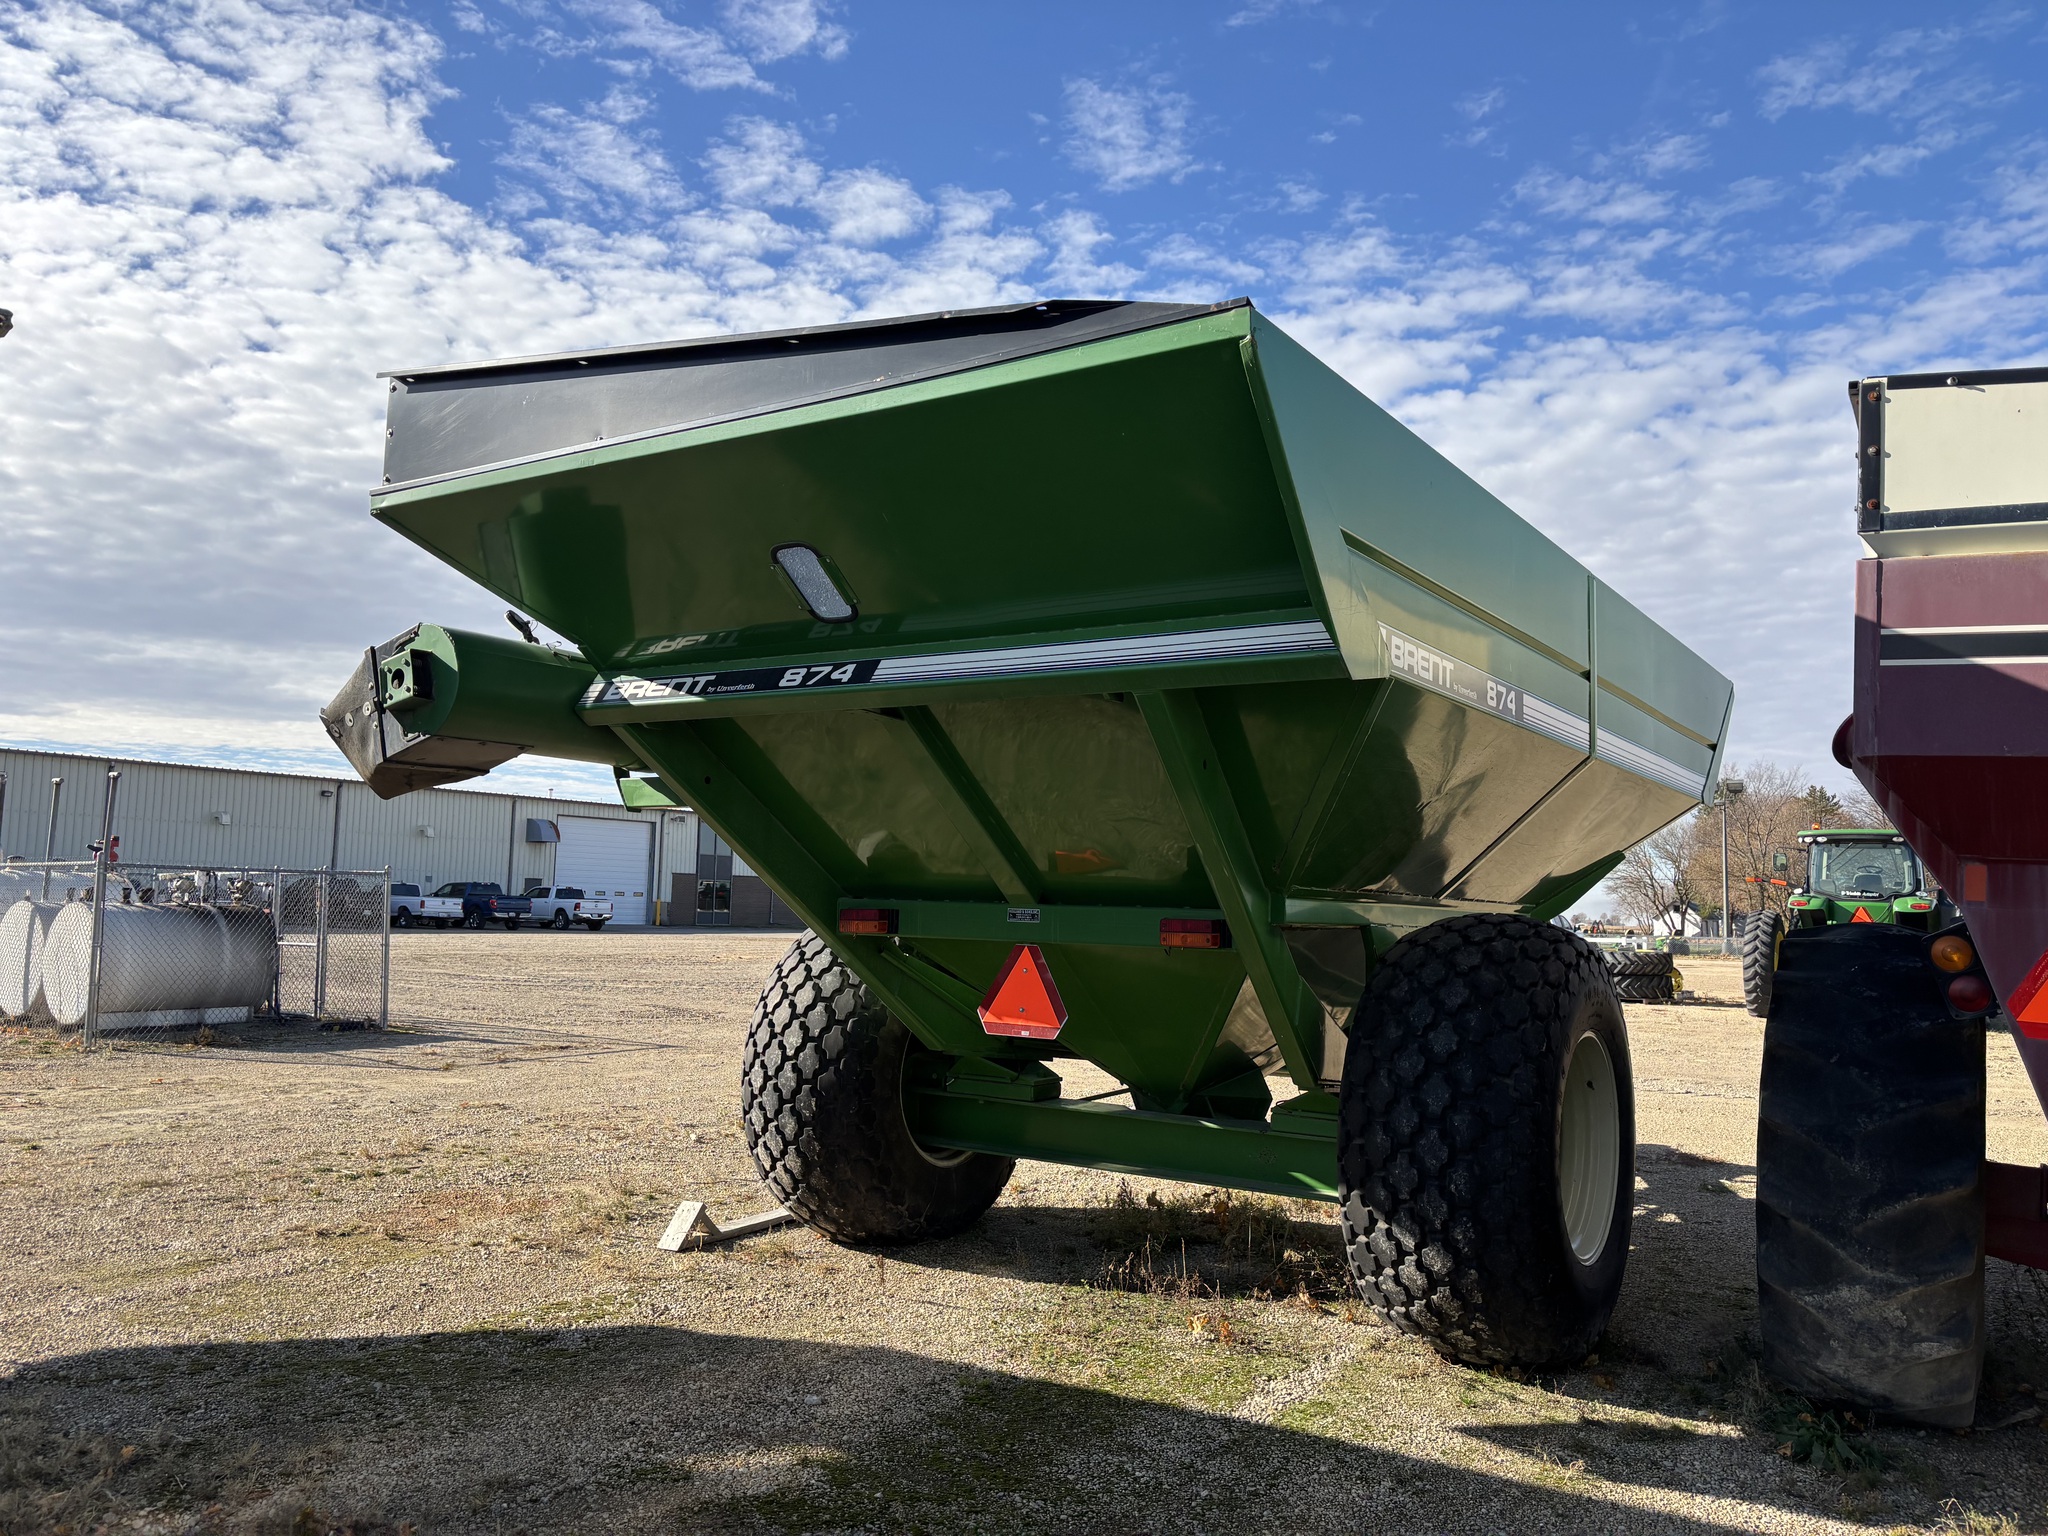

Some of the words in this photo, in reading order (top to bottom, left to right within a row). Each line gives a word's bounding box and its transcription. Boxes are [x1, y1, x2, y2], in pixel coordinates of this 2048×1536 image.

[602, 675, 717, 700] BRENT
[778, 663, 857, 687] 874
[1391, 635, 1454, 688] BRENT
[1487, 680, 1515, 715] 874
